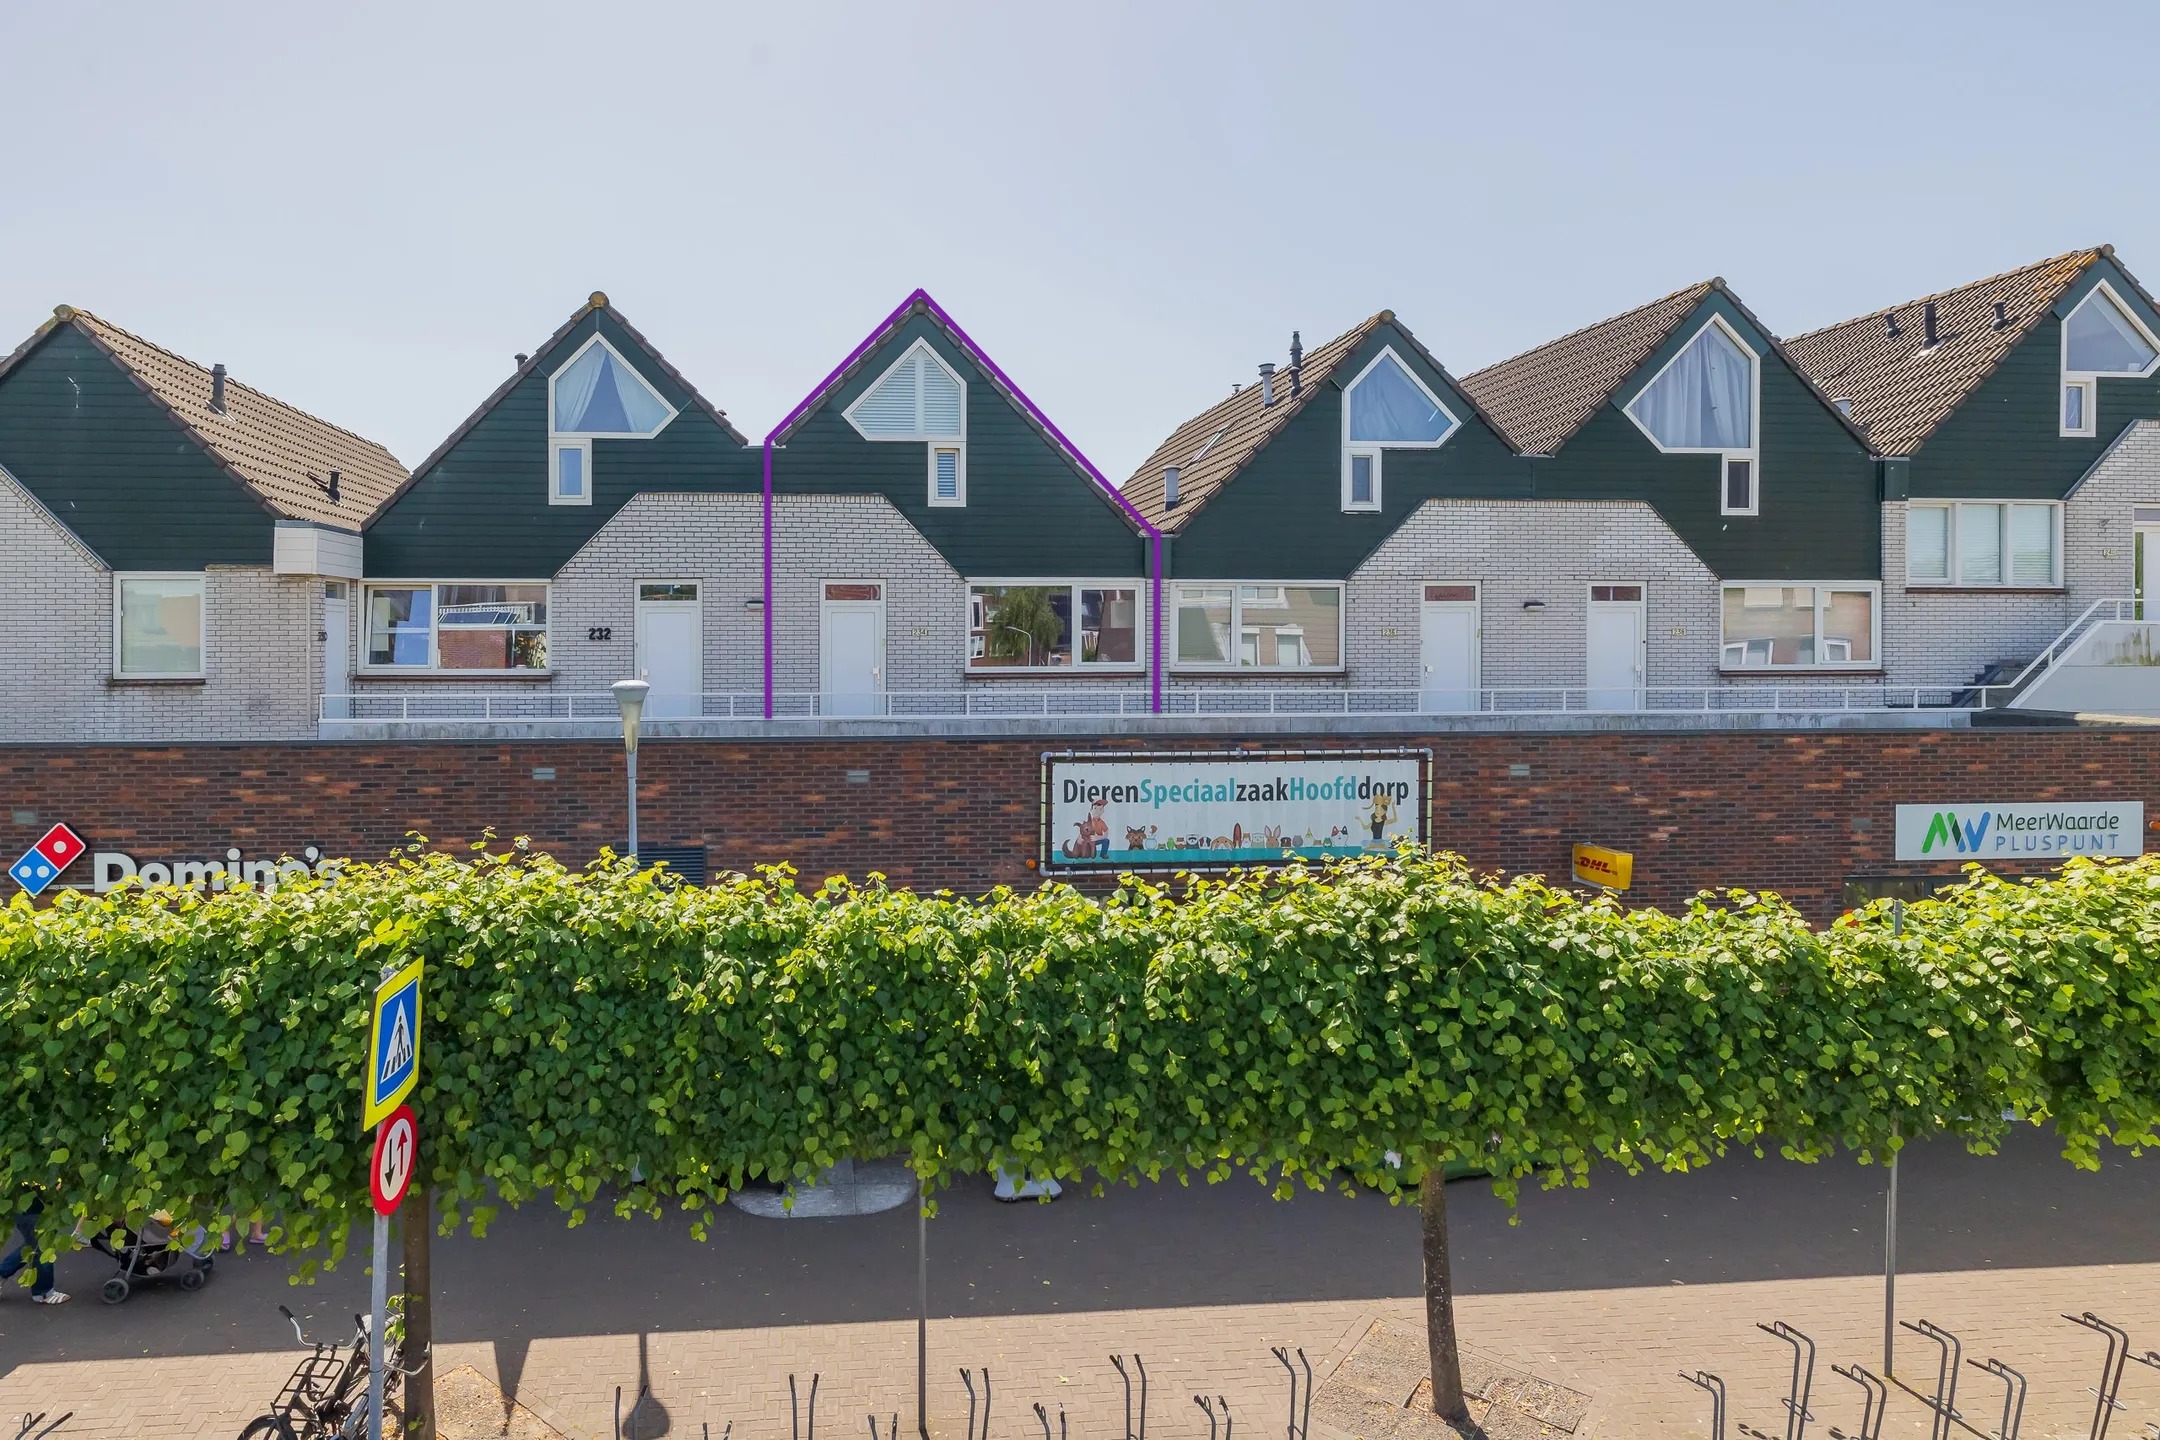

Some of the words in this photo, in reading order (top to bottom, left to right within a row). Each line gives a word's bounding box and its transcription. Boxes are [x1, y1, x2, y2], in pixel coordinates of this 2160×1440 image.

[589, 627, 611, 640] 232
[1063, 776, 1410, 809] DierenSpeciaalzaakHoofddorp
[1996, 811, 2119, 831] MeerWaarde
[1994, 833, 2119, 851] PLUSPUNT
[1578, 856, 1611, 874] DHL
